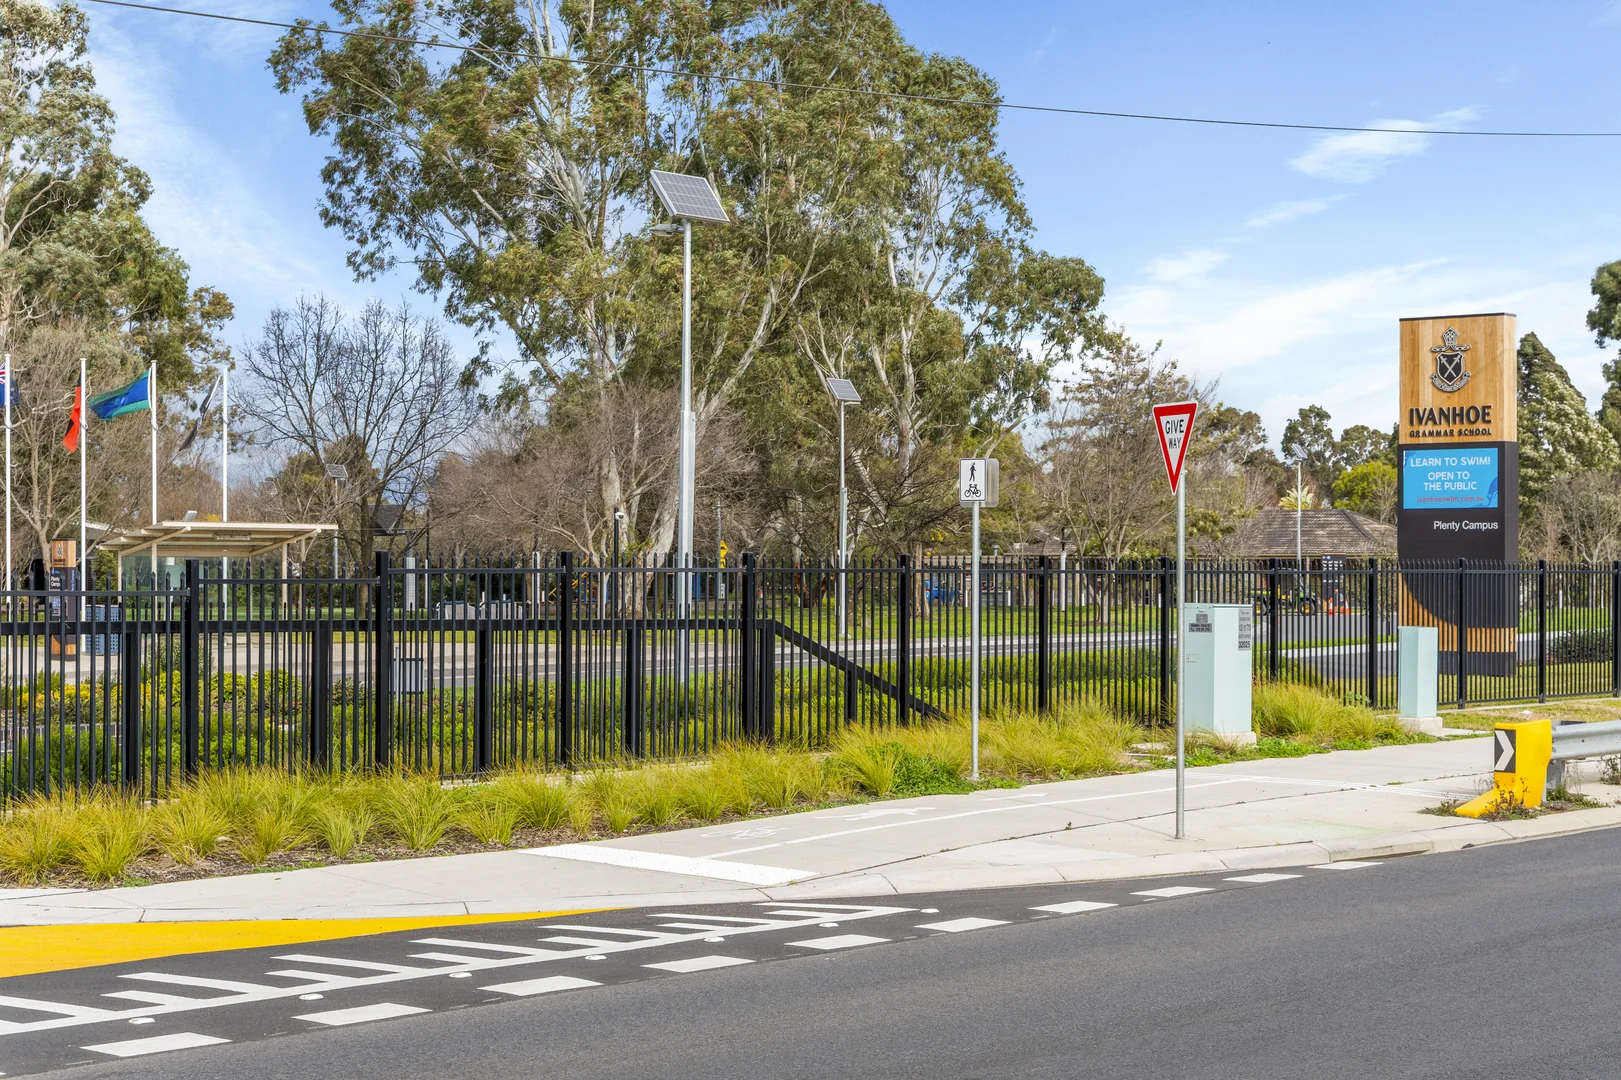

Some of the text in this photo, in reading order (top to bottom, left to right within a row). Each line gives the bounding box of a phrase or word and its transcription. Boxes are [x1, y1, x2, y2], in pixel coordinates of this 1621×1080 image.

[1409, 405, 1492, 427] IVANHOE
[1165, 419, 1184, 434] GIVE
[1409, 428, 1492, 438] GRAMMAR SCHOOL
[1168, 437, 1181, 449] WAY
[1410, 456, 1491, 467] LEARN TO SWIM!
[1427, 471, 1470, 480] OPEN TO
[1423, 481, 1477, 491] THE PUBLIC
[1433, 520, 1499, 532] Plenty Campus
